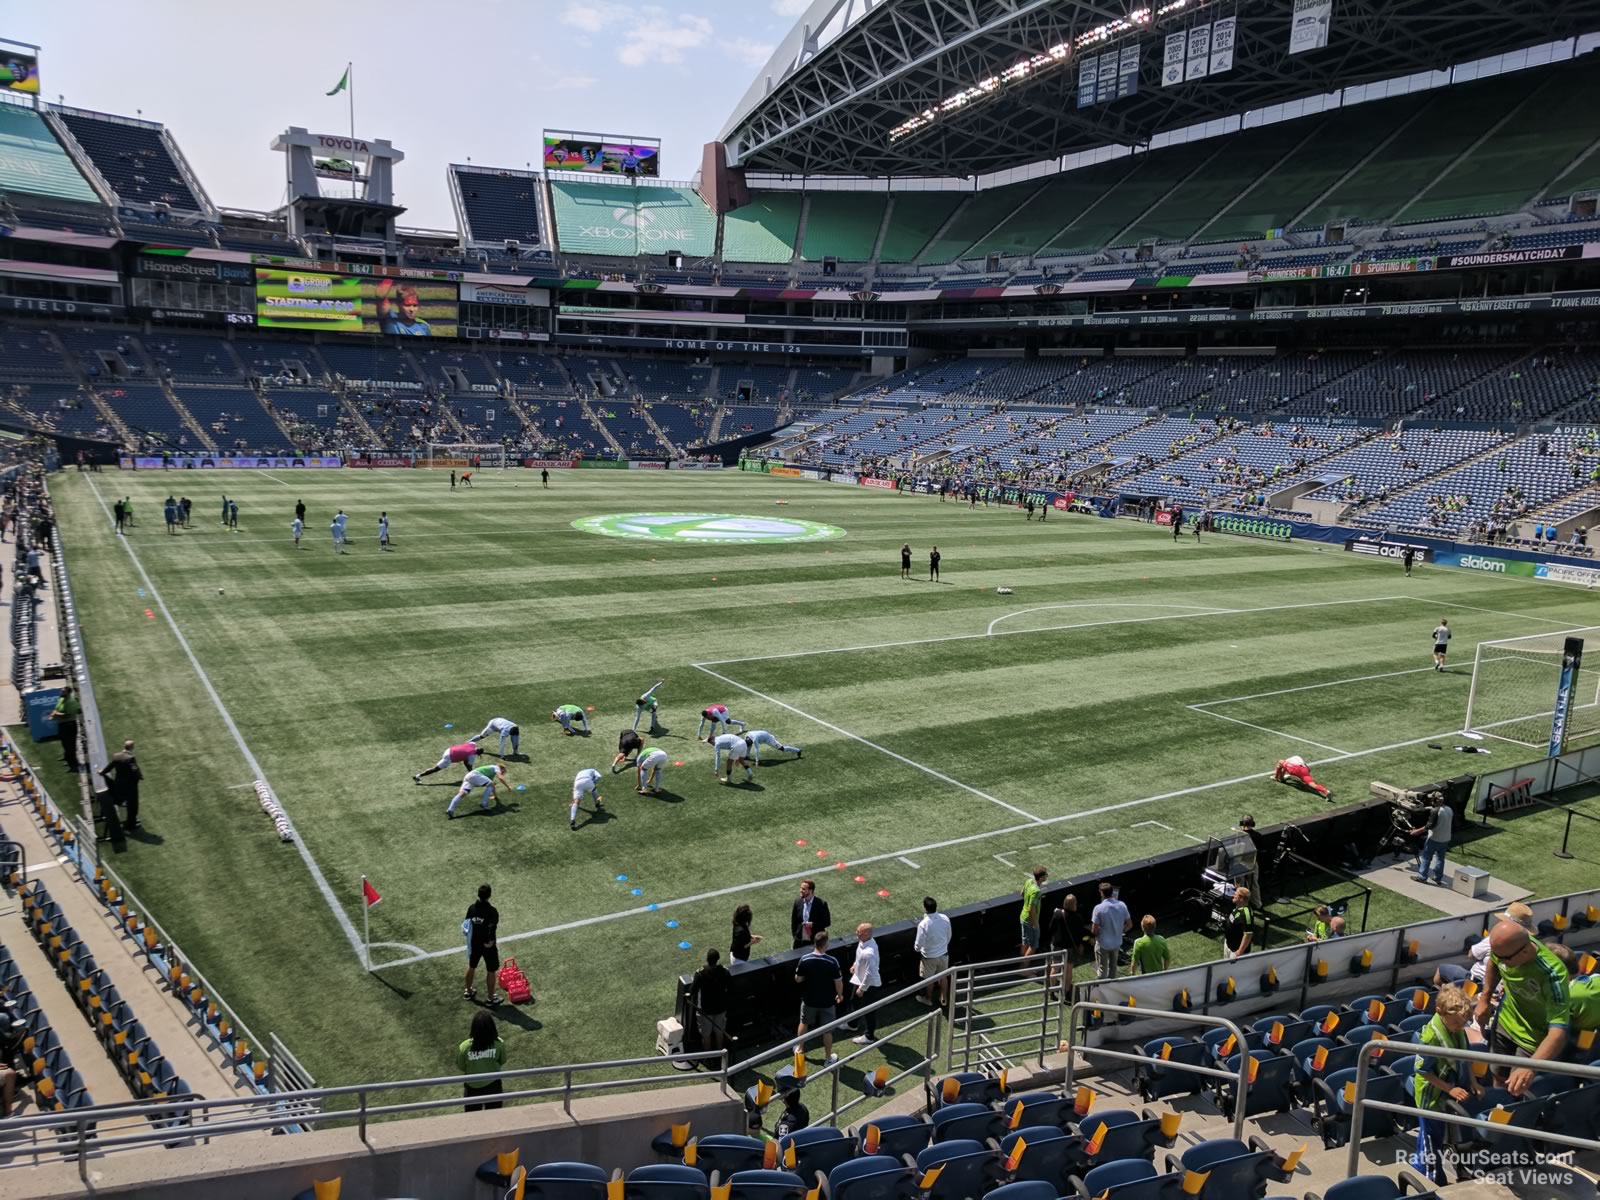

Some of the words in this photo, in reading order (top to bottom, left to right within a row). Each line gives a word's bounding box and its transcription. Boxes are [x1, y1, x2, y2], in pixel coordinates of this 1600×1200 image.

[1216, 30, 1232, 41] 2014
[1191, 38, 1206, 48] 2013
[1217, 40, 1229, 48] NFC
[1168, 44, 1182, 54] 2005
[1193, 47, 1204, 55] NFC
[318, 136, 369, 152] TOYOTA
[579, 225, 640, 239] XBOX
[645, 228, 695, 240] ONE
[1450, 248, 1566, 266] #SOUNDERSMATCHDAY
[223, 266, 251, 279] Bank
[352, 264, 370, 274] 16:47
[382, 267, 388, 275] 0
[1311, 267, 1317, 278] 0
[1326, 265, 1346, 277] 16:47
[1355, 263, 1361, 275] 0
[1367, 262, 1399, 274] SPORTING
[1400, 261, 1411, 271] KC
[1267, 270, 1297, 279] SOUNDERS
[1298, 269, 1306, 278] FC
[477, 290, 505, 298] AMERICAN
[14, 299, 76, 313] FIELD
[266, 296, 320, 308] STARTING
[1461, 303, 1471, 311] 45
[1472, 301, 1493, 311] KENNY
[1494, 300, 1517, 310] EASLEY
[1551, 298, 1562, 307] 17
[1562, 297, 1580, 307] DAVE
[166, 311, 205, 319] STARBUCKS
[1382, 306, 1391, 315] 79
[1392, 306, 1408, 314] JACOB
[1410, 305, 1428, 314] GREEN
[1140, 316, 1147, 324] 10
[1254, 311, 1265, 320] PETE
[666, 340, 706, 350] HOME
[716, 342, 734, 351] OF
[744, 343, 769, 352] THE
[780, 344, 801, 353] 12s
[1297, 416, 1320, 424] DELTA
[1460, 556, 1505, 573] slalom
[1549, 567, 1575, 576] PACIFIC
[1553, 687, 1569, 743] SEATTLE
